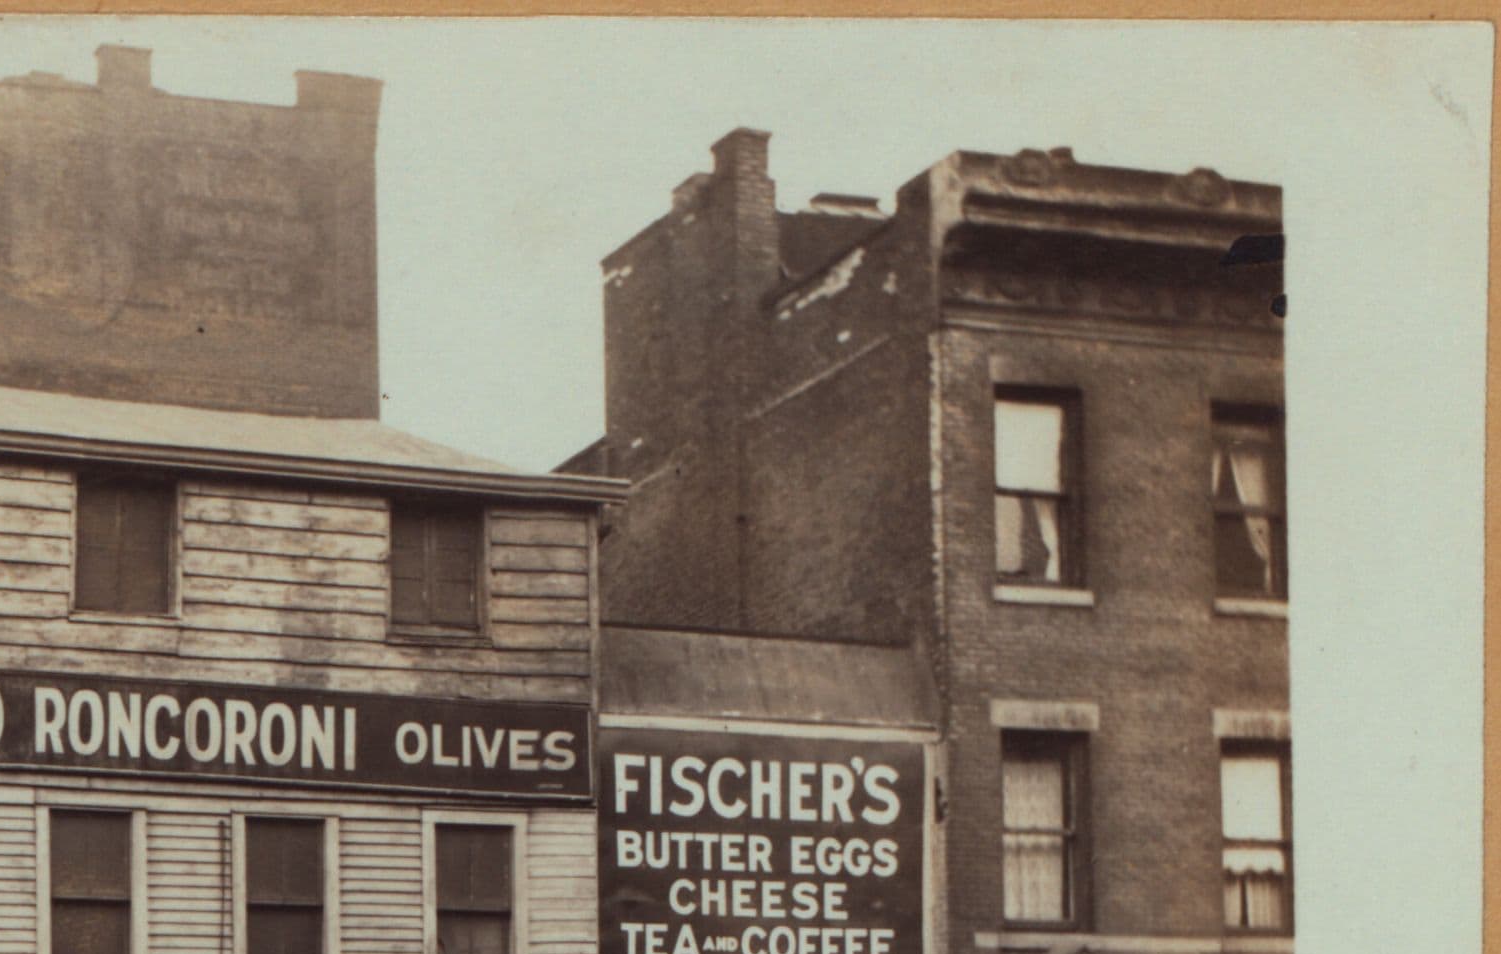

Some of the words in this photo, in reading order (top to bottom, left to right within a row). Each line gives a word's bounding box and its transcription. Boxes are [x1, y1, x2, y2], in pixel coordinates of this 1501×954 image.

[34, 686, 357, 772] RONCORONI
[395, 721, 577, 772] OLIVES
[614, 753, 901, 825] FISCHER'S
[616, 829, 773, 873] BUTTER
[790, 836, 899, 877] EGGS
[669, 879, 848, 920] CHEESE
[703, 936, 738, 953] AND
